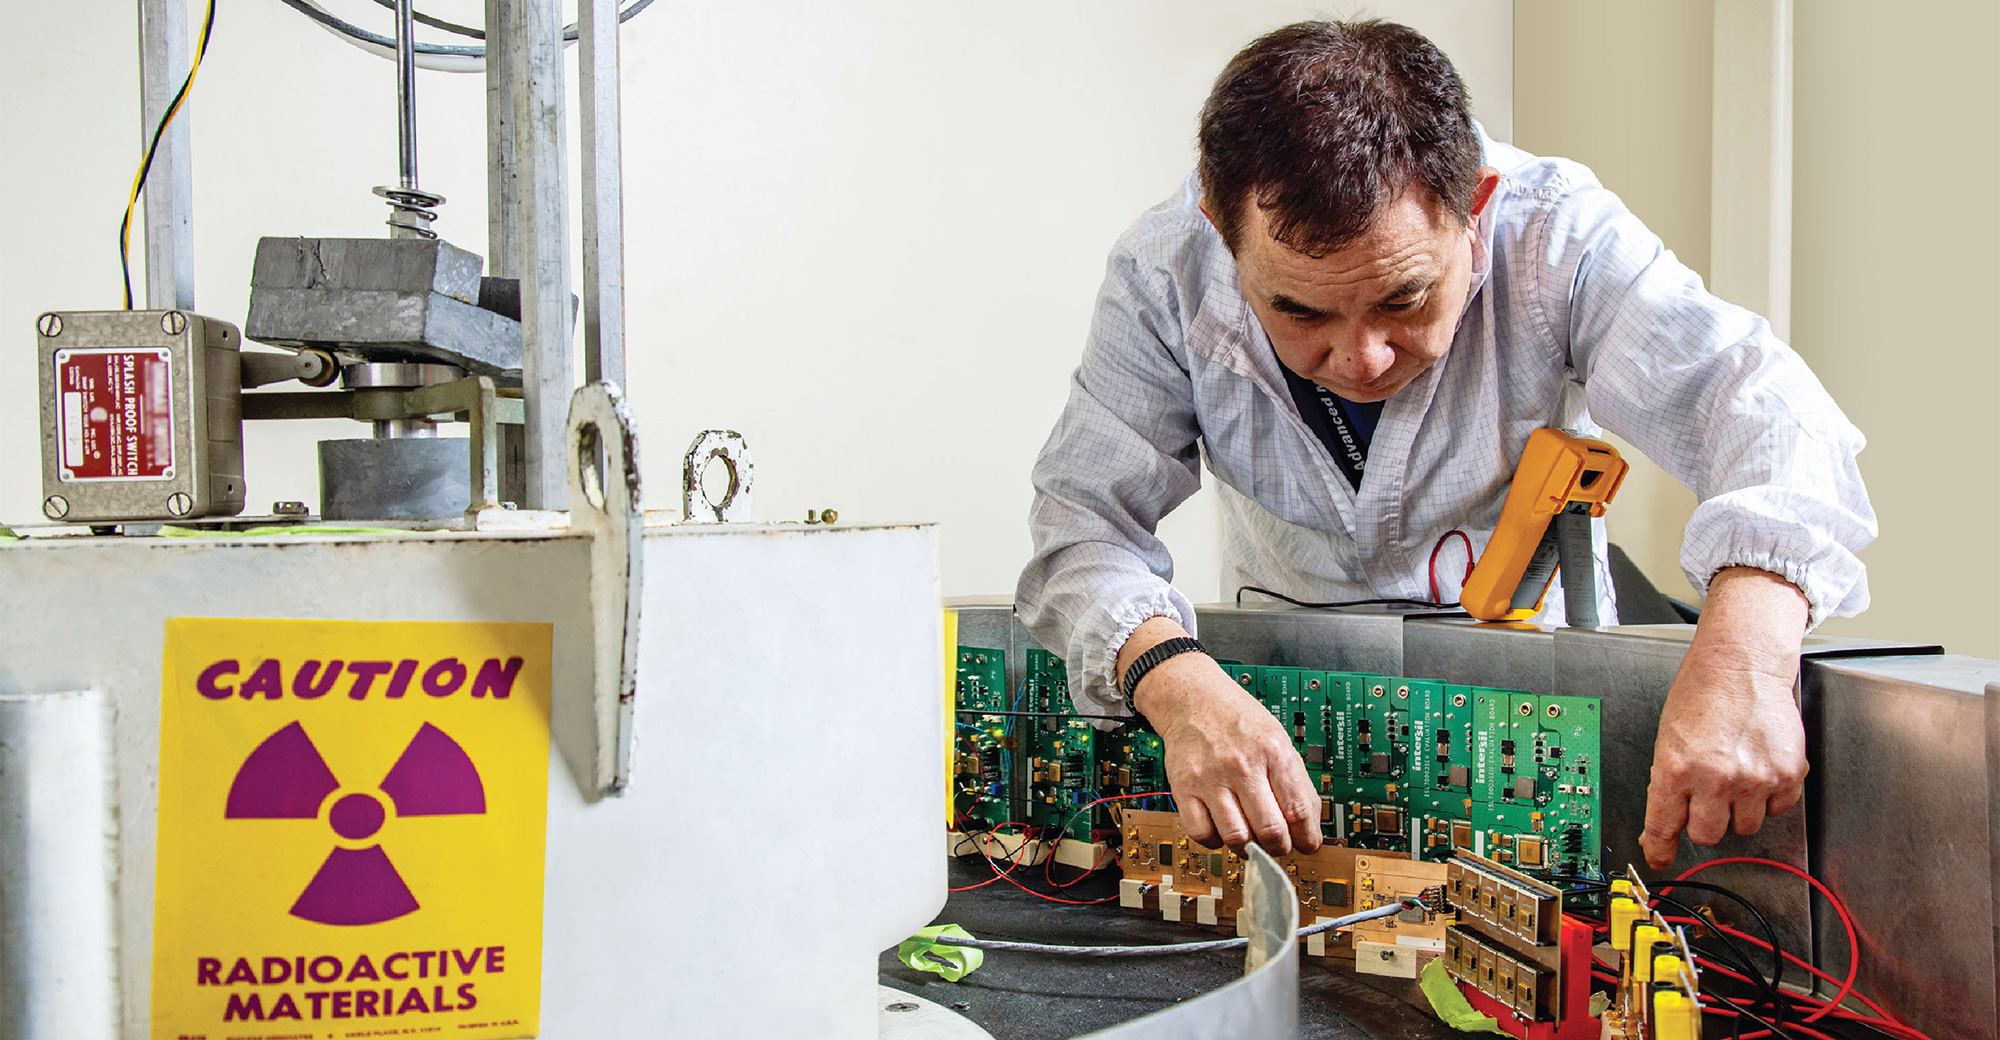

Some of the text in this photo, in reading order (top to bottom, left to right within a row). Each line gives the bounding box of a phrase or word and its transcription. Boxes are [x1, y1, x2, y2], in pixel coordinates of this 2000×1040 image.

[123, 355, 138, 476] SPLASH PROOF SWITCH
[1321, 397, 1366, 470] Advanced
[196, 656, 524, 701] CAUTION
[1335, 711, 1345, 760] intersil
[1412, 720, 1424, 771] intersil
[1475, 730, 1488, 784] intersil
[197, 946, 505, 986] RADIOACTIVE
[223, 982, 477, 1022] MATERIALS
